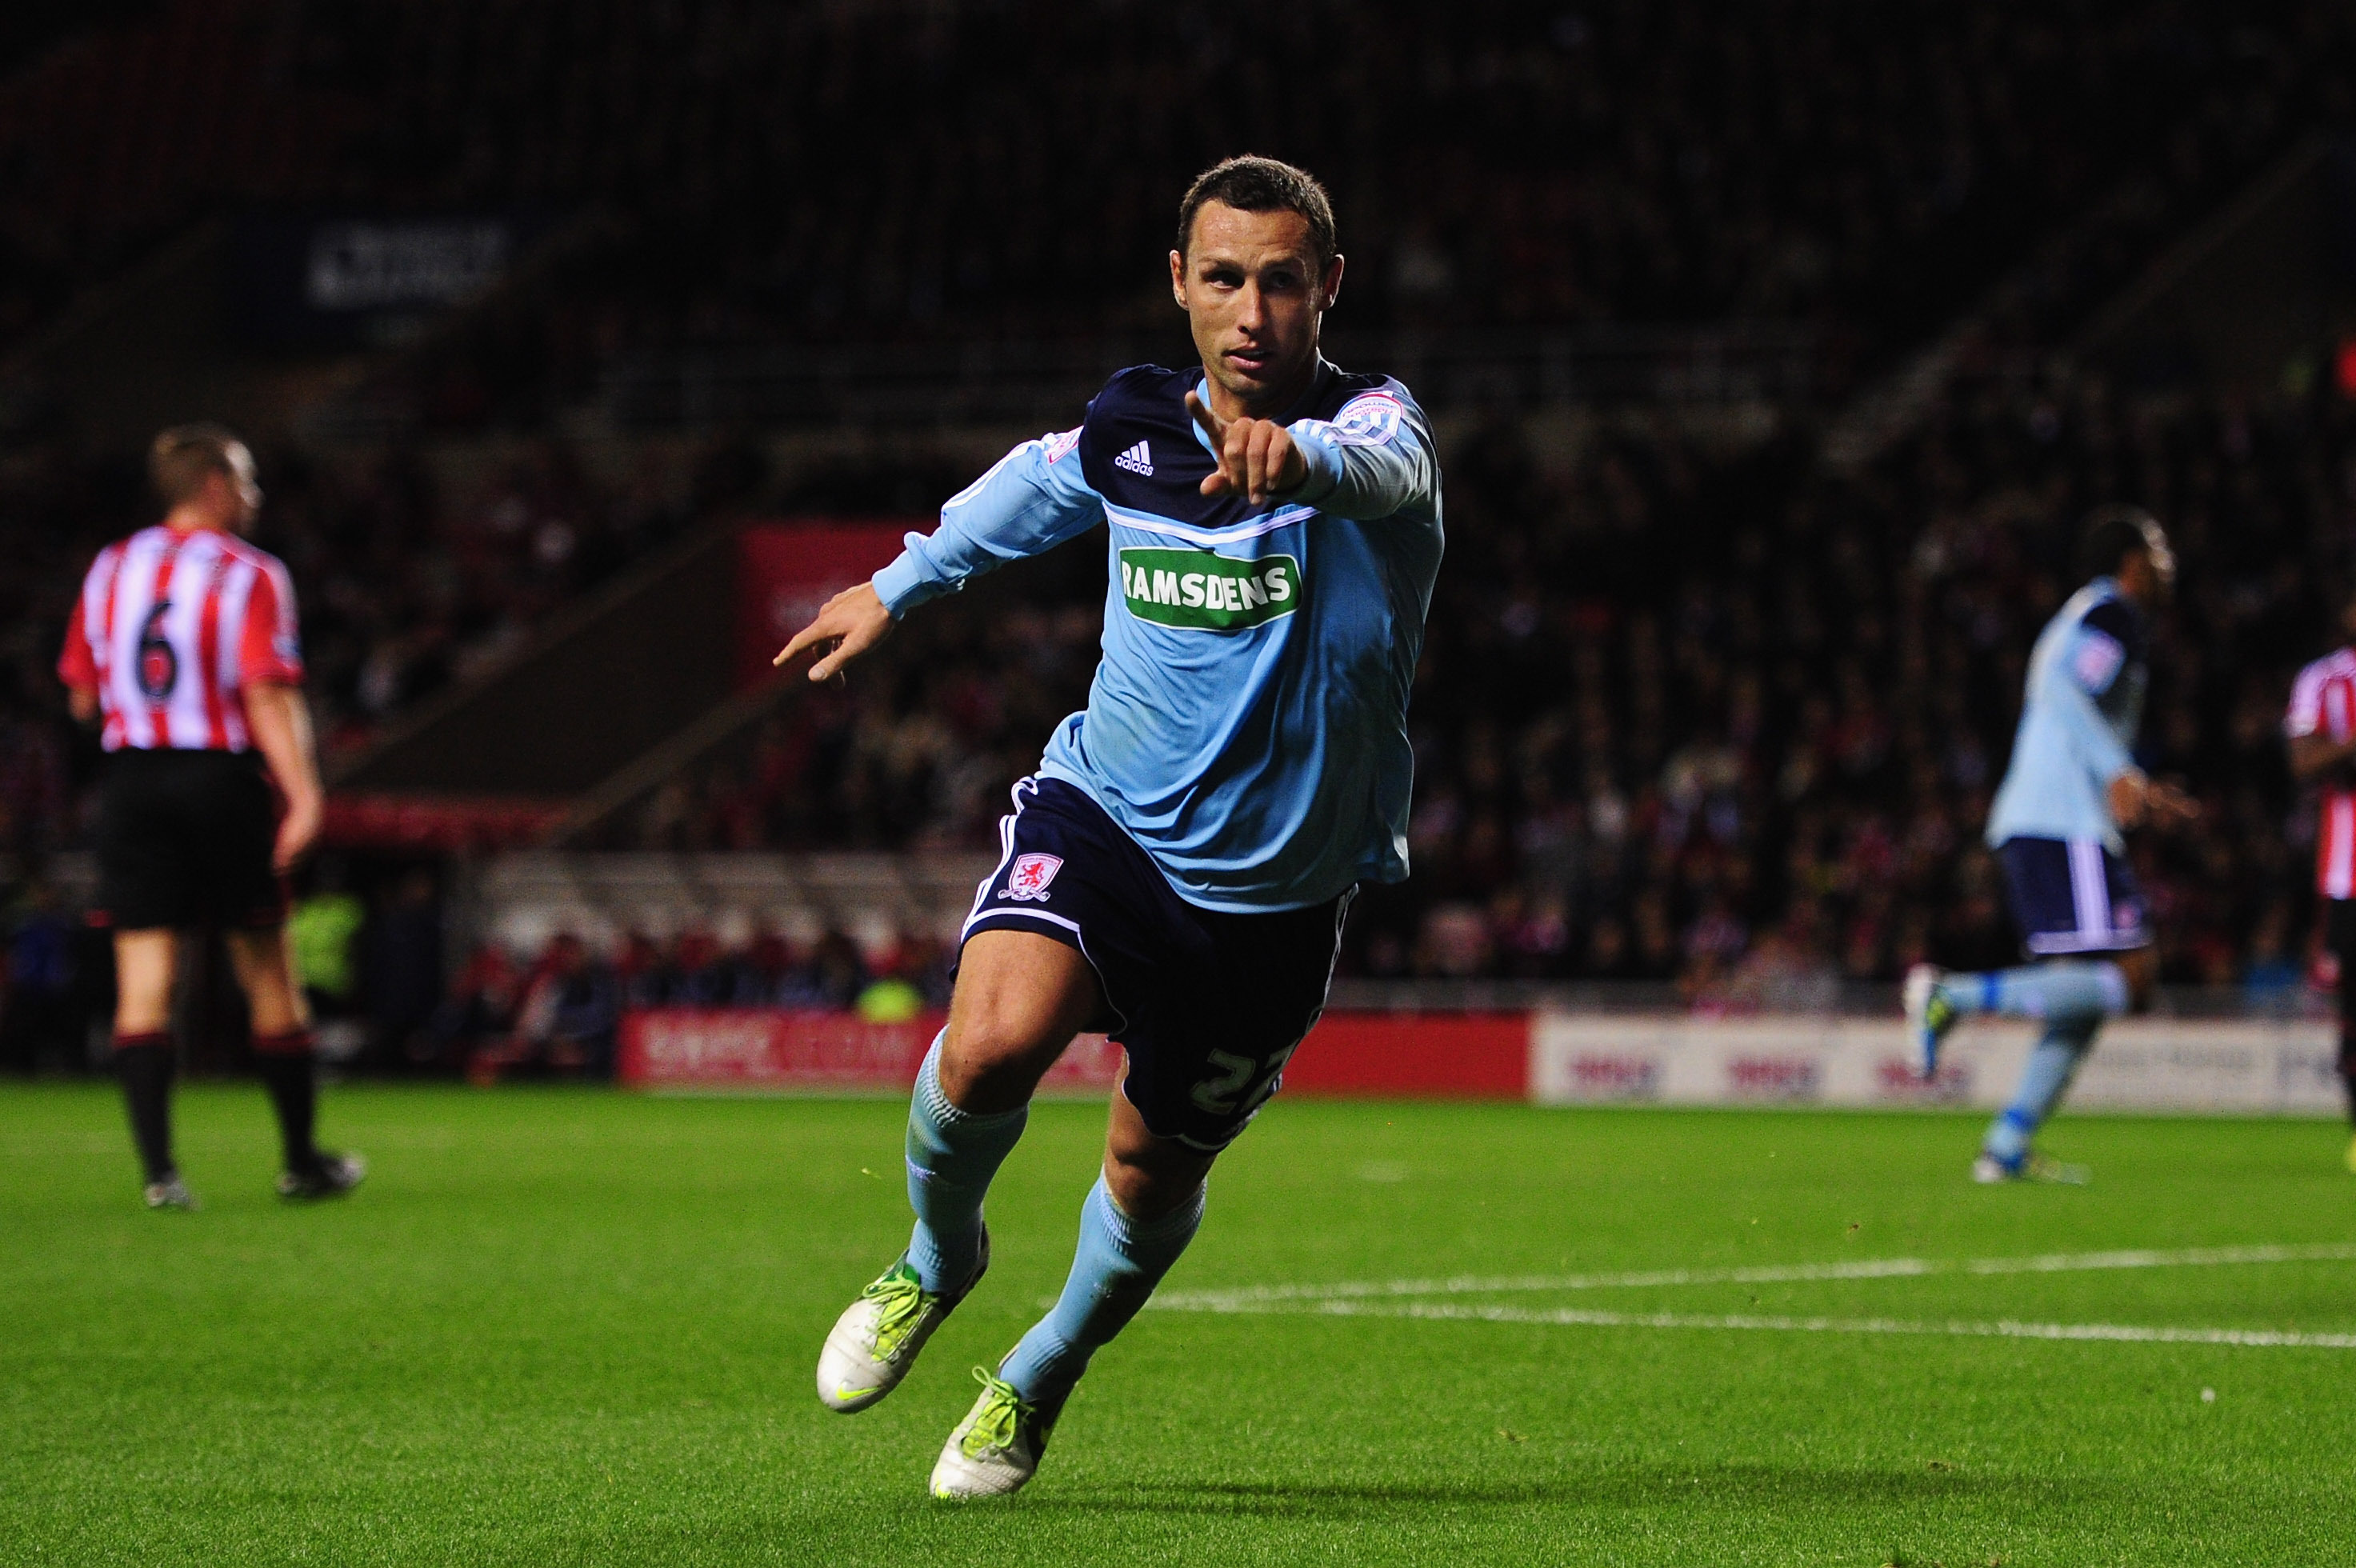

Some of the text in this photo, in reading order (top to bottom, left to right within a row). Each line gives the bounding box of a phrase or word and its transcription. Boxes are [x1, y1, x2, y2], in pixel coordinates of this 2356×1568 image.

[1114, 455, 1154, 477] adidas
[1122, 561, 1290, 611] RAMSDENS
[134, 598, 179, 698] 6
